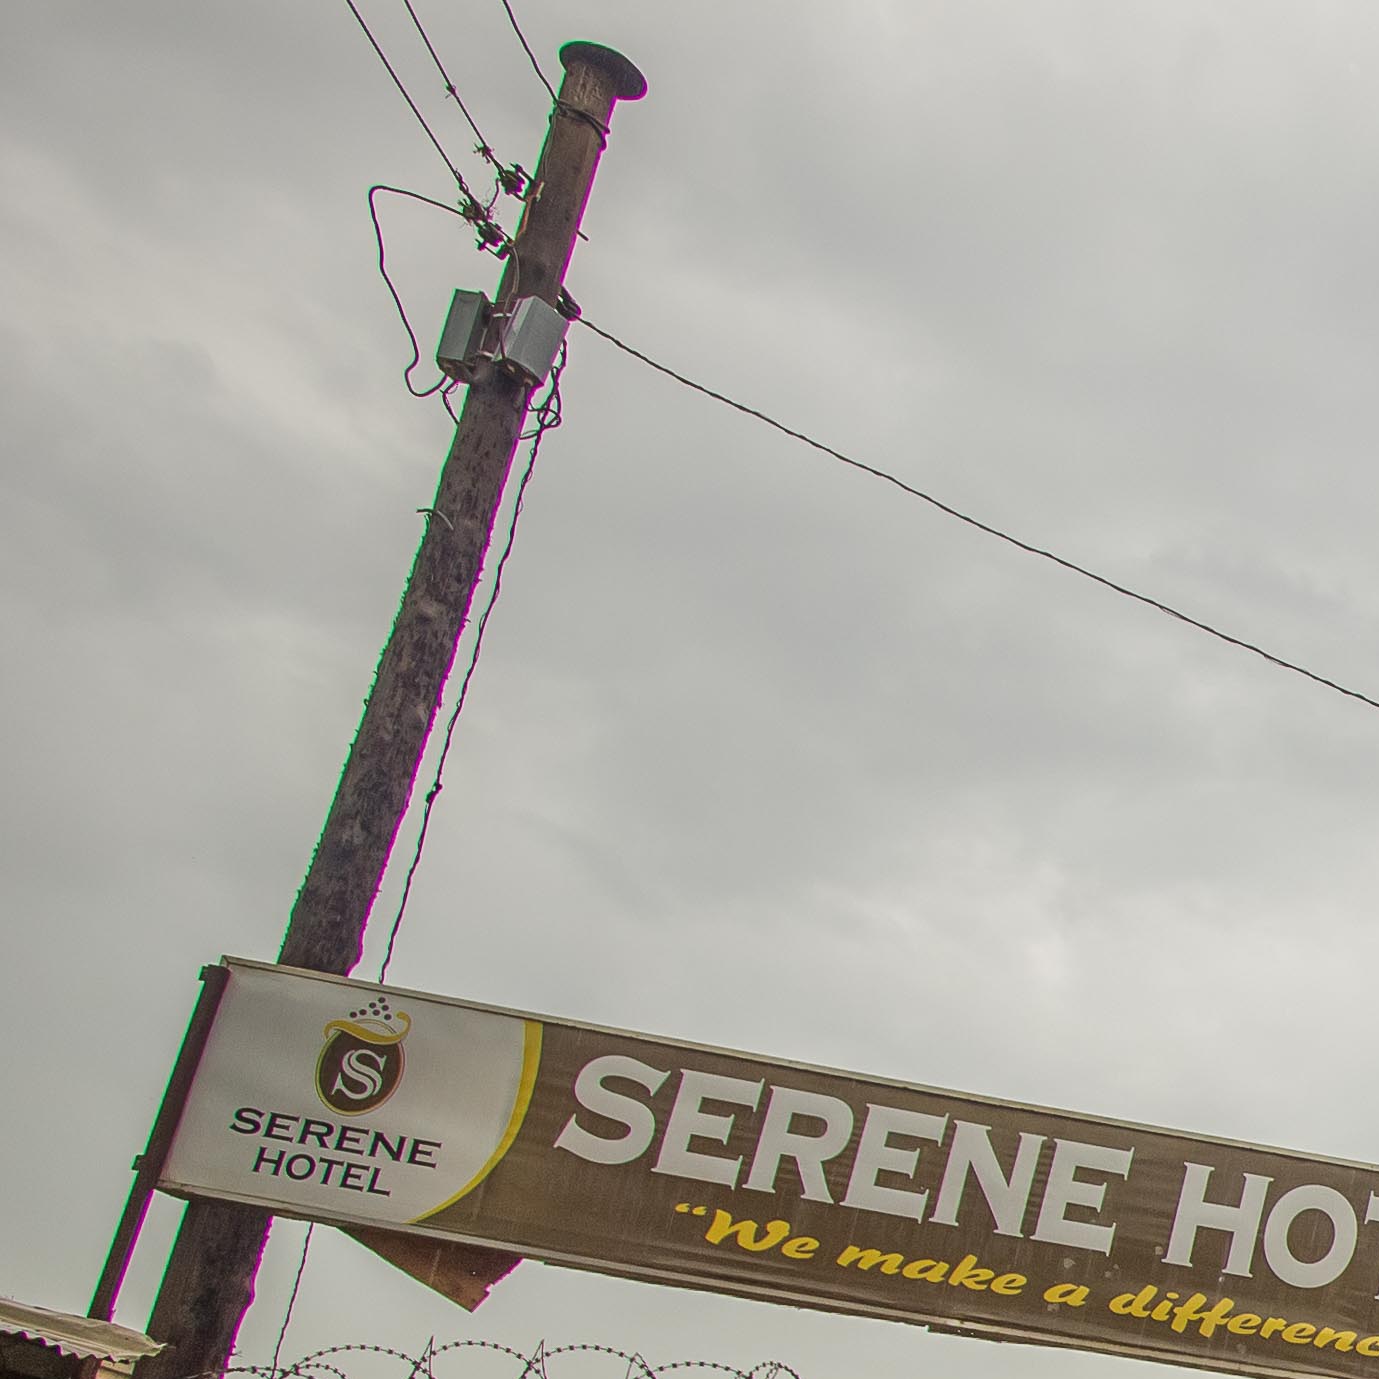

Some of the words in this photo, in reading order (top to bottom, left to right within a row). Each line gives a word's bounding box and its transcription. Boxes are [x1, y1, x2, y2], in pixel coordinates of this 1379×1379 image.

[332, 1049, 389, 1101] S
[229, 1107, 442, 1169] SERENE
[553, 1055, 1135, 1257] SERENE
[252, 1147, 391, 1197] HOTEL
[836, 1244, 1028, 1296] make
[1044, 1282, 1089, 1307] a
